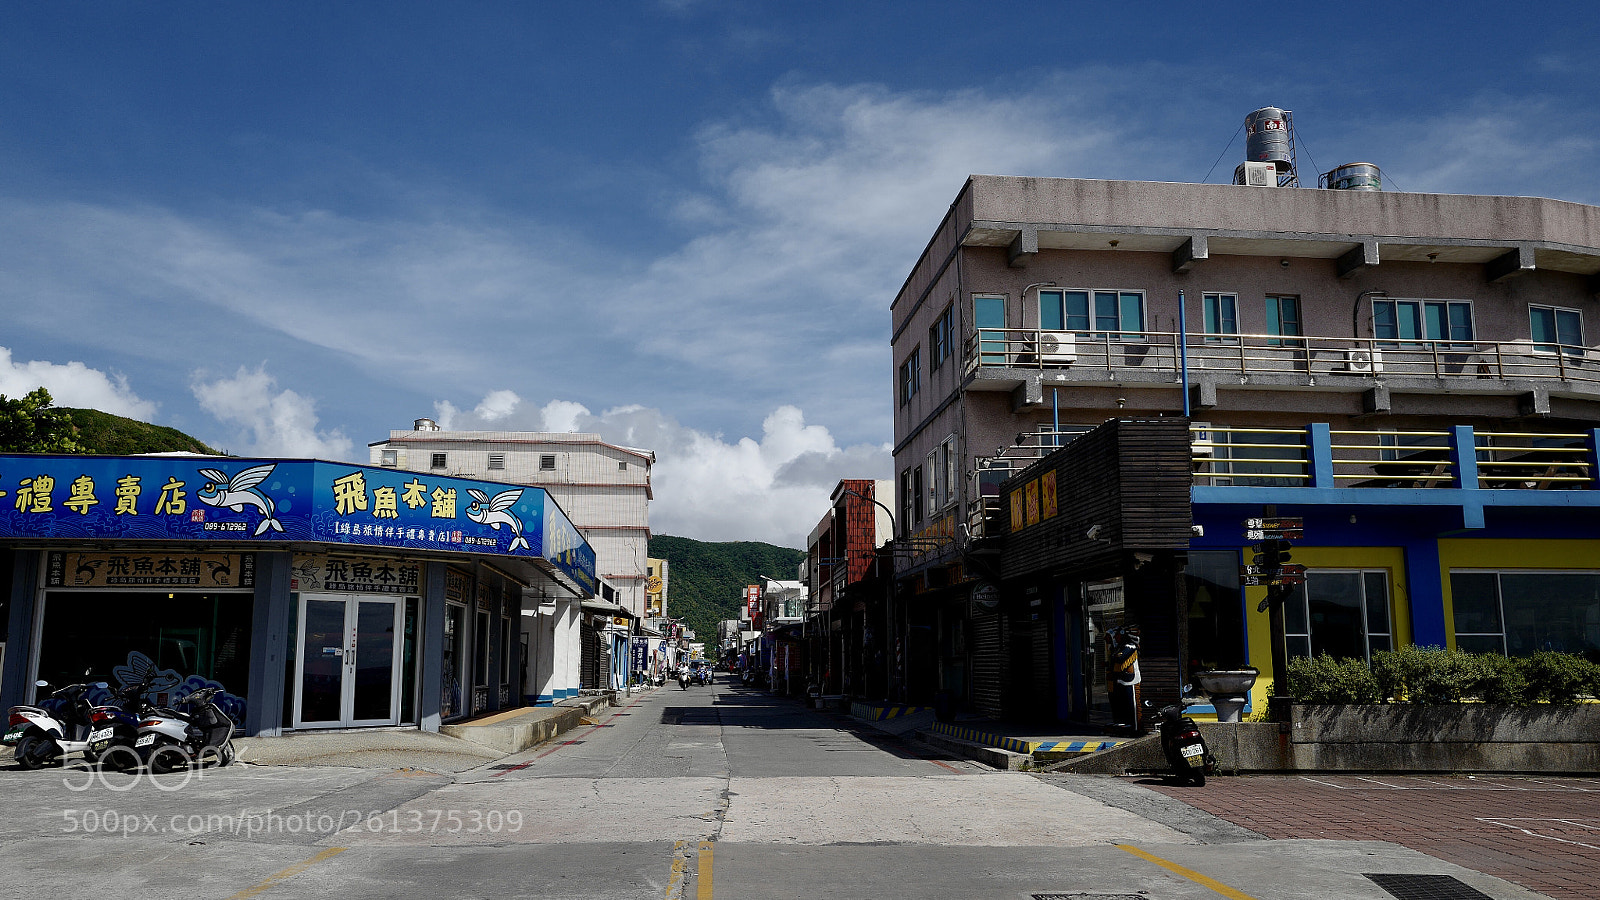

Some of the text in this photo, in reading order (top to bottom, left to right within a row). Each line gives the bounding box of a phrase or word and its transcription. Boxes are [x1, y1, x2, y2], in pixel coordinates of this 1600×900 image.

[0, 473, 188, 516] 禮專賣店
[333, 470, 458, 520] 飛魚本舖
[204, 522, 247, 531] 089-672962
[107, 556, 202, 576] 飛魚本舖
[325, 560, 420, 586] 飛魚本舖
